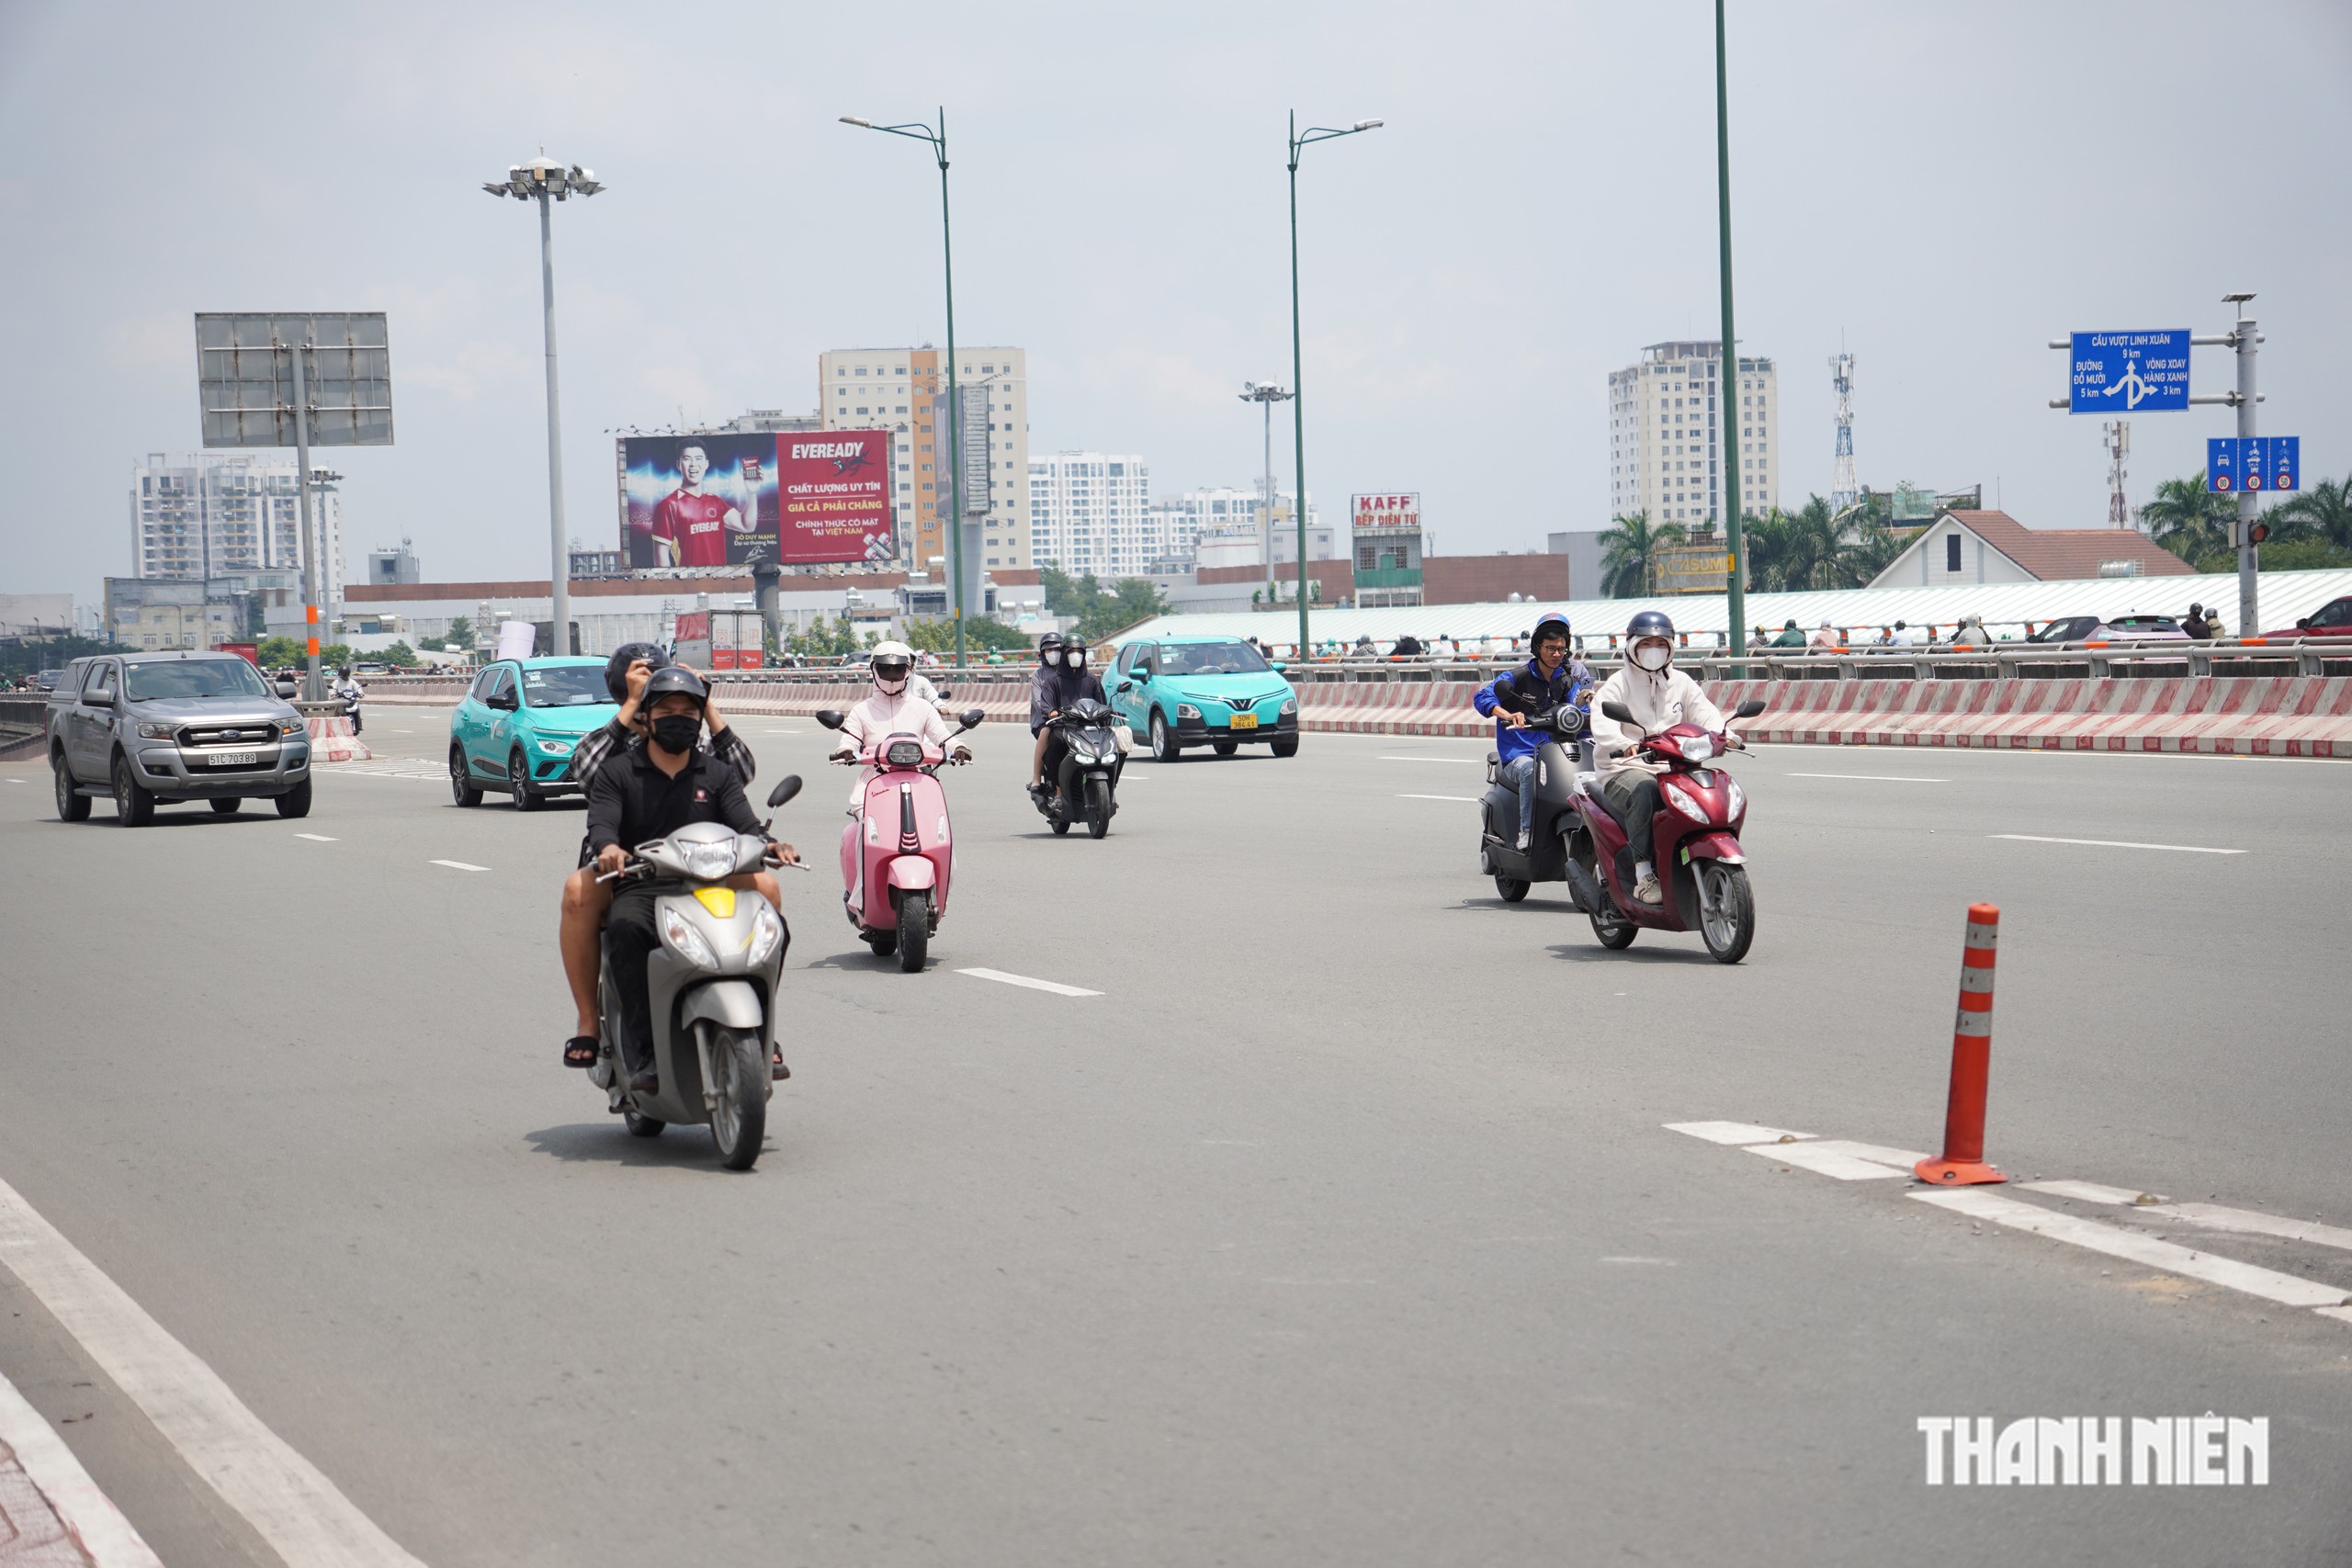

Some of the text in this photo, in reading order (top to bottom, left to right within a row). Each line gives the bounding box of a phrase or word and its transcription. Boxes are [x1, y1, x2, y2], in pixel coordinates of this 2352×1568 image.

[2092, 333, 2170, 348] CẦU VƯỢT LINH XUÂN
[2122, 349, 2141, 358] 9 km
[2075, 359, 2103, 371] ĐƯỜNG
[2145, 357, 2187, 369] VÒNG XOAY
[2074, 373, 2106, 385] ĐỖ MƯỜI
[2143, 371, 2188, 383] HÀNG XANH
[2080, 388, 2099, 398] 5 km
[2163, 386, 2181, 395] 3 km
[792, 442, 864, 459] EVEREADY
[787, 481, 881, 495] CHẤT LƯỢNG UY TÍN
[2219, 479, 2227, 488] 80
[2250, 478, 2258, 487] 60
[2280, 478, 2288, 486] 50
[787, 502, 805, 513] GIÁ
[807, 501, 820, 512] CẢ
[822, 500, 846, 511] PHẢI
[1360, 496, 1410, 511] KAFF
[796, 519, 823, 528] CHÍNH
[811, 528, 824, 537] TẠI
[825, 528, 842, 536] VIỆT
